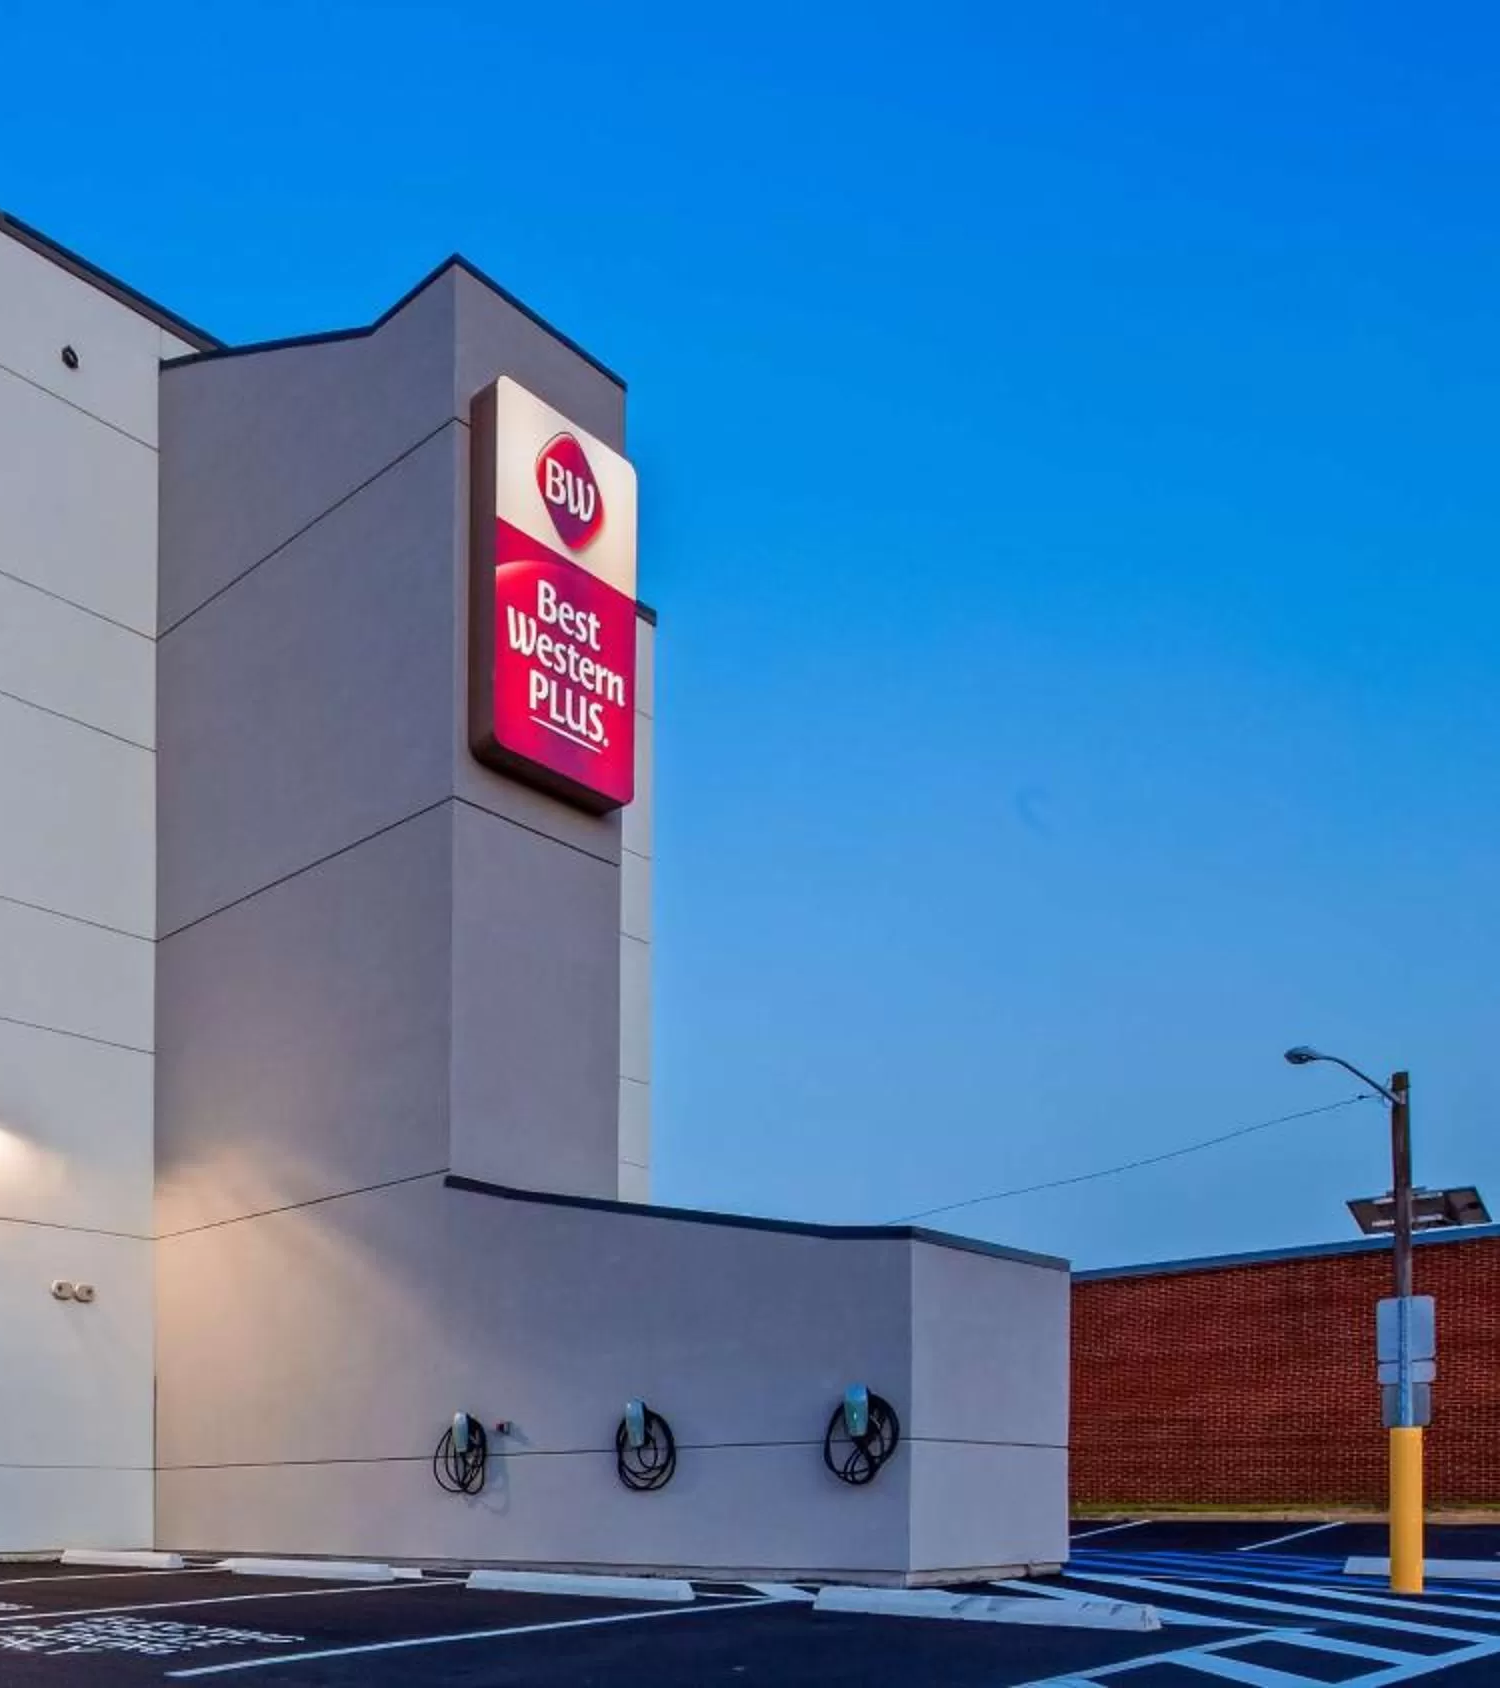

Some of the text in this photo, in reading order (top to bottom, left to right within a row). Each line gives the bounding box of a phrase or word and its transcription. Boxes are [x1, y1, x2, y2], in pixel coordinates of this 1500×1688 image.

[543, 457, 596, 524] BW
[537, 579, 601, 651] Best
[507, 605, 625, 707] Western
